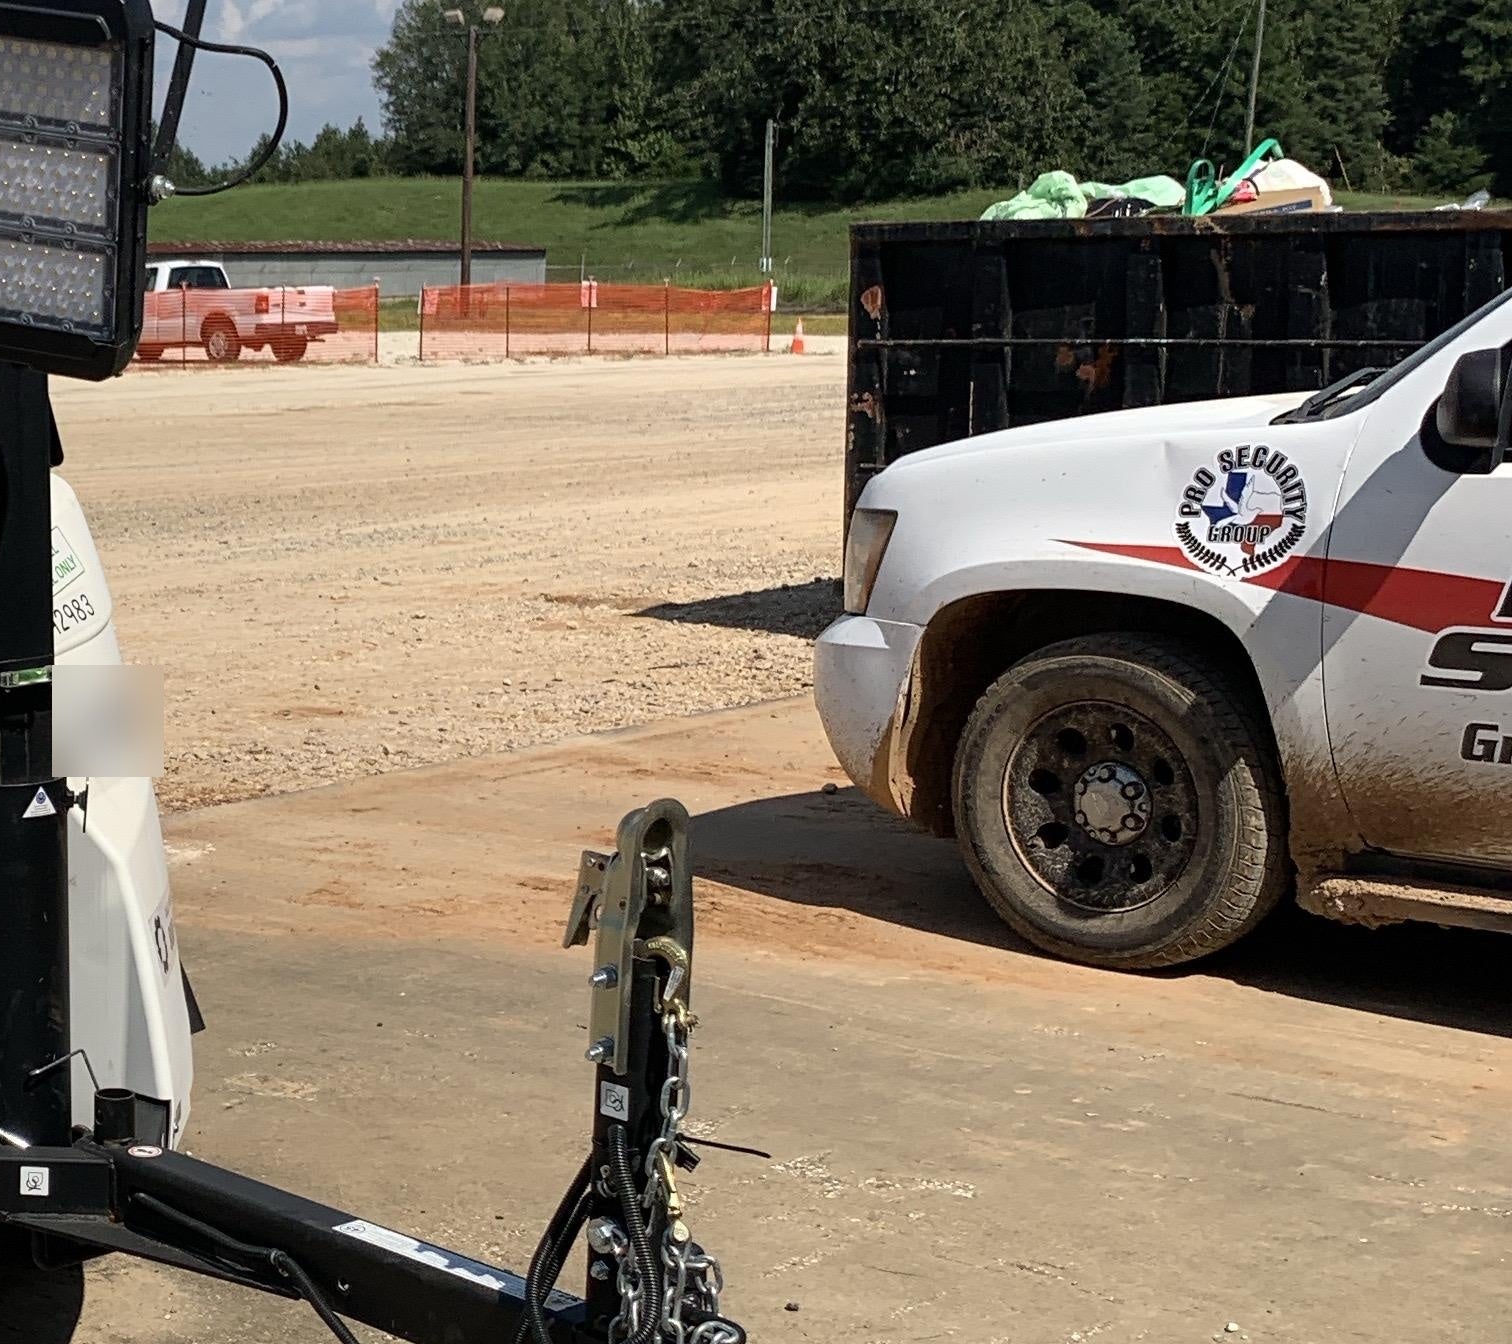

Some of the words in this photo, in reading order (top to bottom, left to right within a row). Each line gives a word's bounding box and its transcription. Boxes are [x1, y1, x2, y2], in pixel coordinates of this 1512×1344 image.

[1178, 466, 1216, 518] PRO
[1217, 444, 1307, 524] SECURITY
[1207, 525, 1272, 543] GROUP
